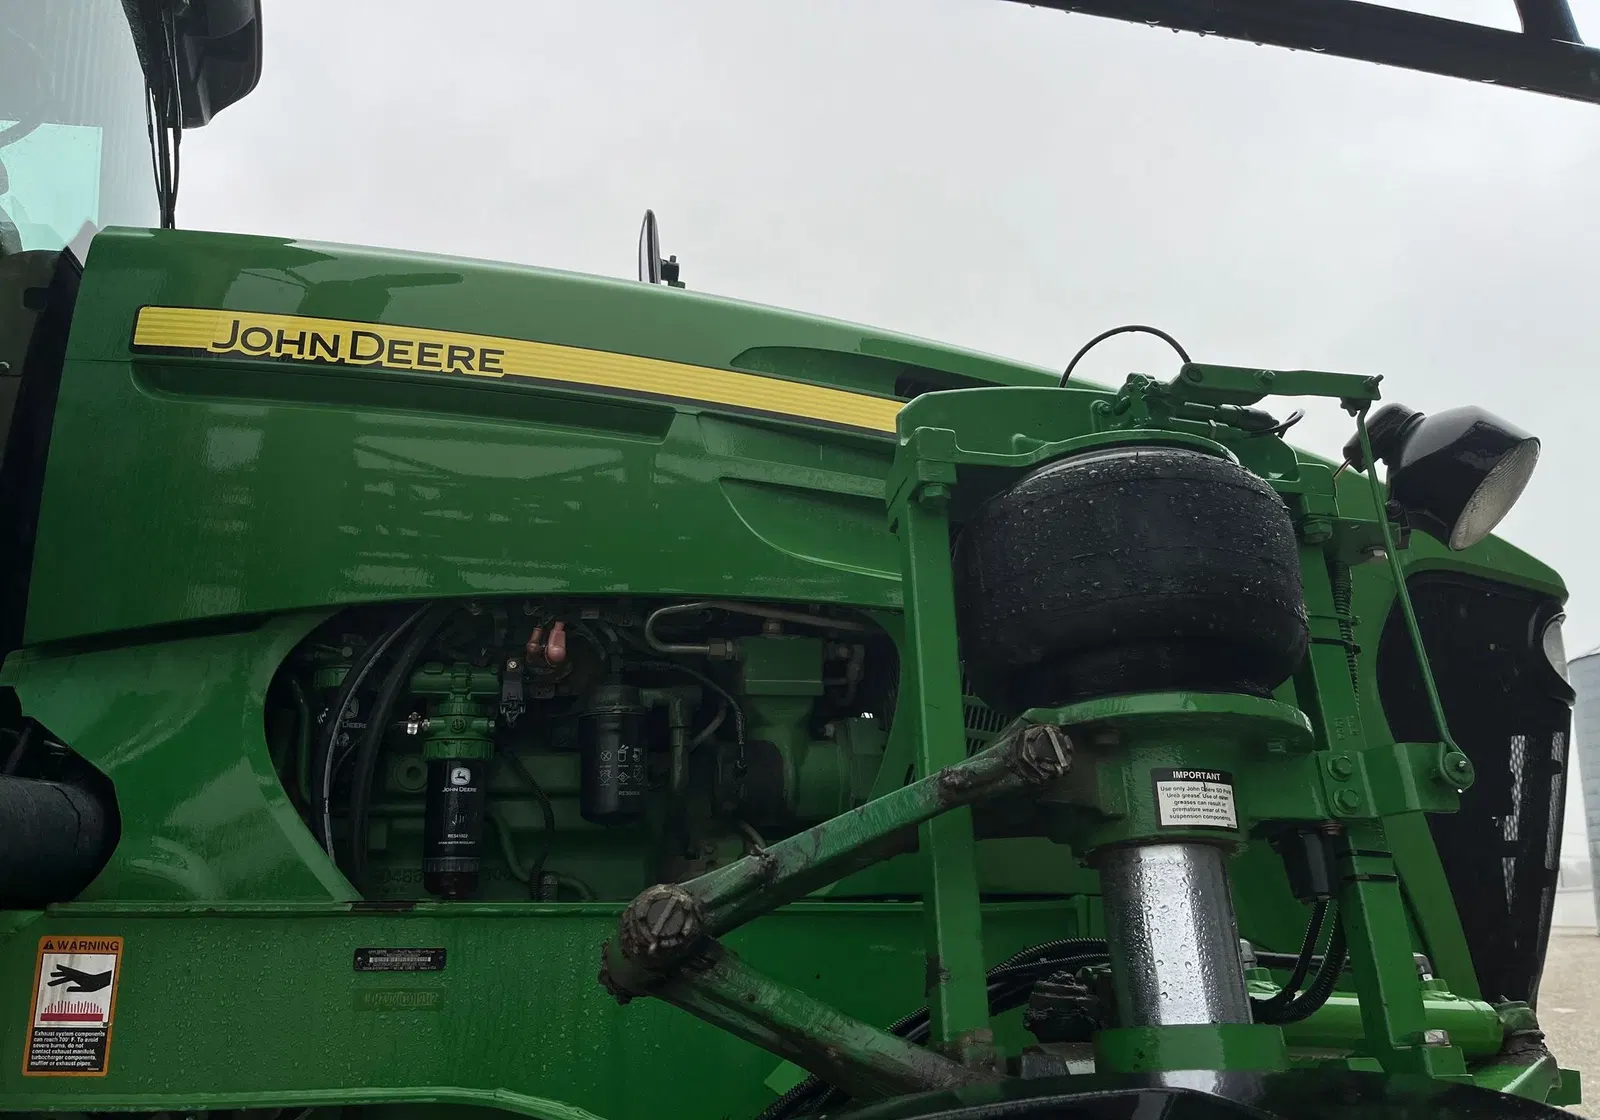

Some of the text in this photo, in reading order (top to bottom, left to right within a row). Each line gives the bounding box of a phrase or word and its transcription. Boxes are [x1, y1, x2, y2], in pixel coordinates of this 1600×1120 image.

[212, 319, 505, 374] JOHN DEERE
[1173, 771, 1221, 780] IMPORTANT
[57, 940, 119, 951] WARNING
